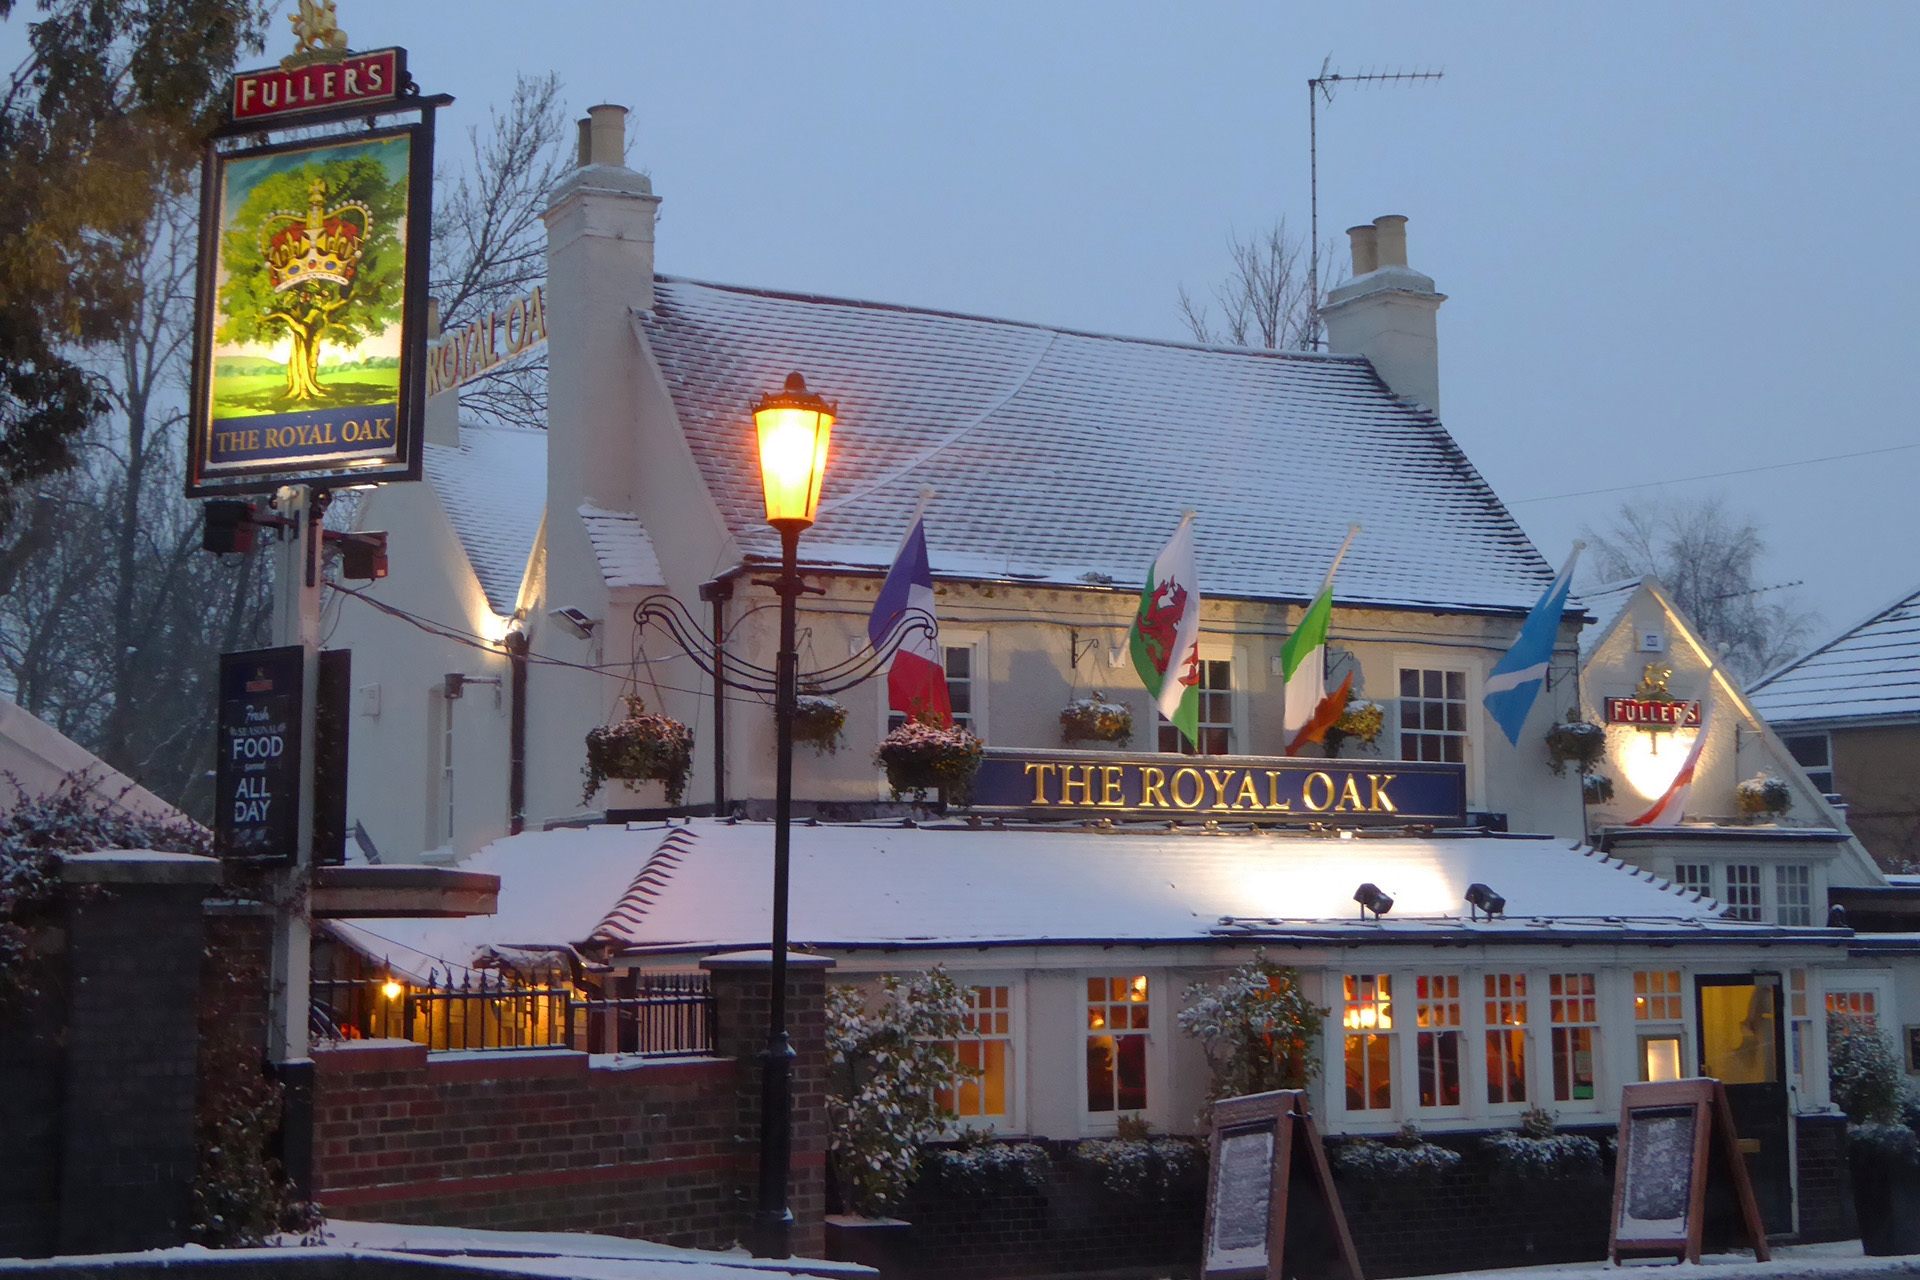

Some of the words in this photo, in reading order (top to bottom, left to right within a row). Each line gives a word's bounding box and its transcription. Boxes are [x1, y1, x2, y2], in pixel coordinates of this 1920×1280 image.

[242, 62, 382, 111] FULLER'S
[427, 312, 499, 398] ROYAL
[505, 286, 547, 353] OA
[216, 430, 260, 452] THE
[265, 423, 336, 448] ROYAL
[341, 418, 391, 442] OAK
[233, 736, 283, 759] FOOD
[235, 777, 271, 798] ALL
[1025, 762, 1126, 806] THE
[1139, 766, 1291, 810] ROYAL
[1302, 771, 1398, 812] OAK
[235, 800, 271, 822] DAY
